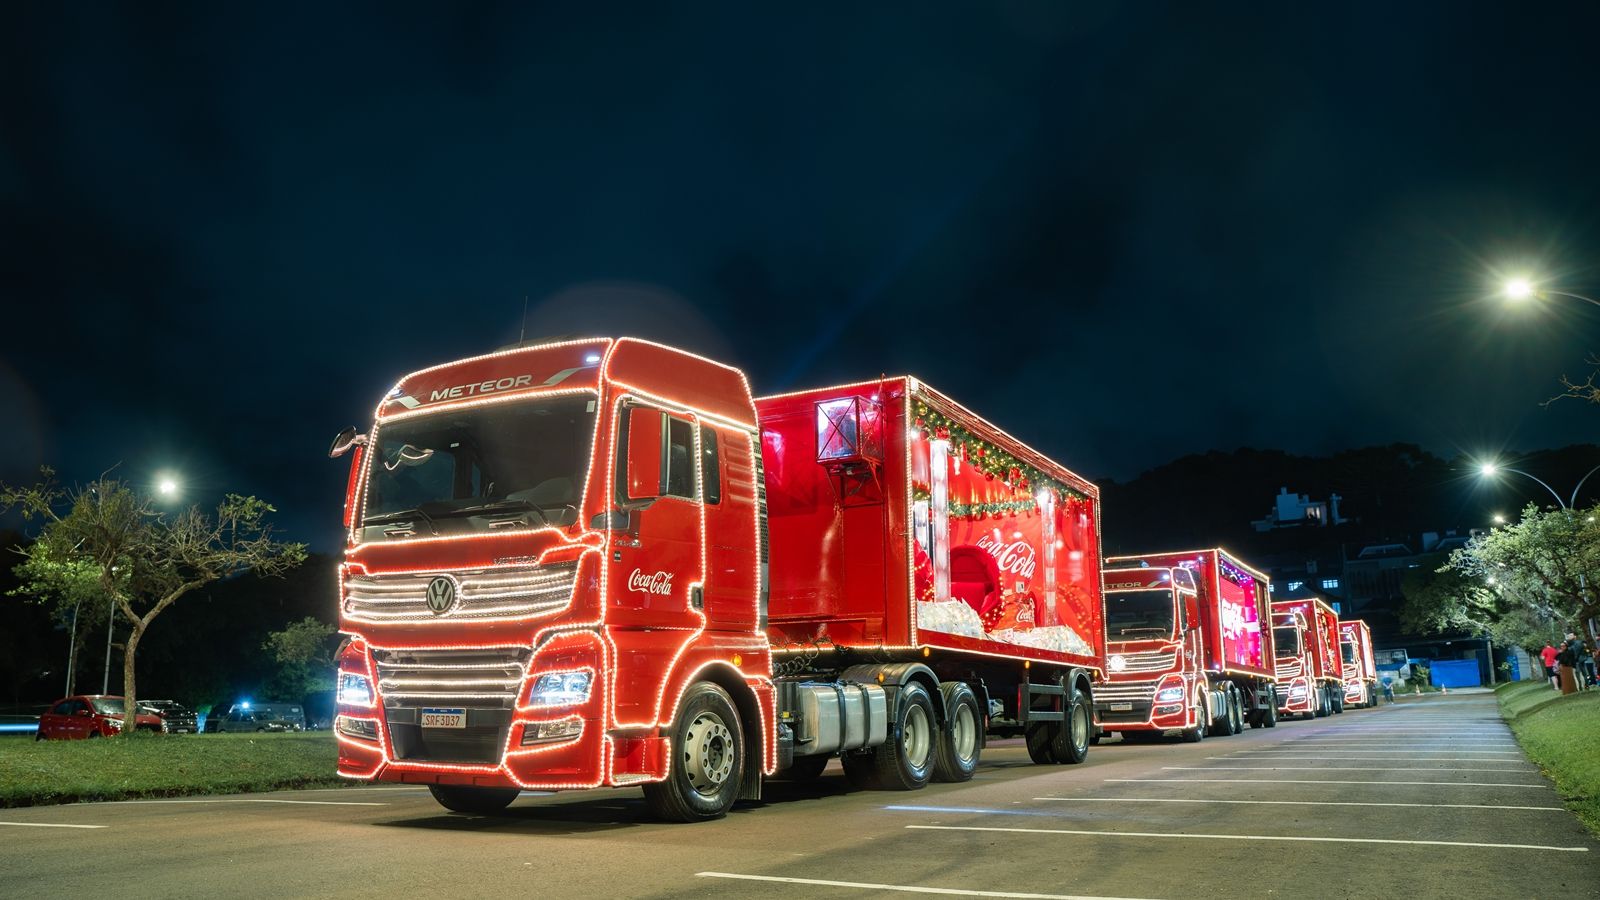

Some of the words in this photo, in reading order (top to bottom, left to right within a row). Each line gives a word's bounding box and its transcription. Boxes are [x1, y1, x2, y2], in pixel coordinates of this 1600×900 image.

[430, 375, 532, 401] METEOR
[628, 568, 674, 595] Coca-Cola
[425, 715, 460, 726] SRF3D37
